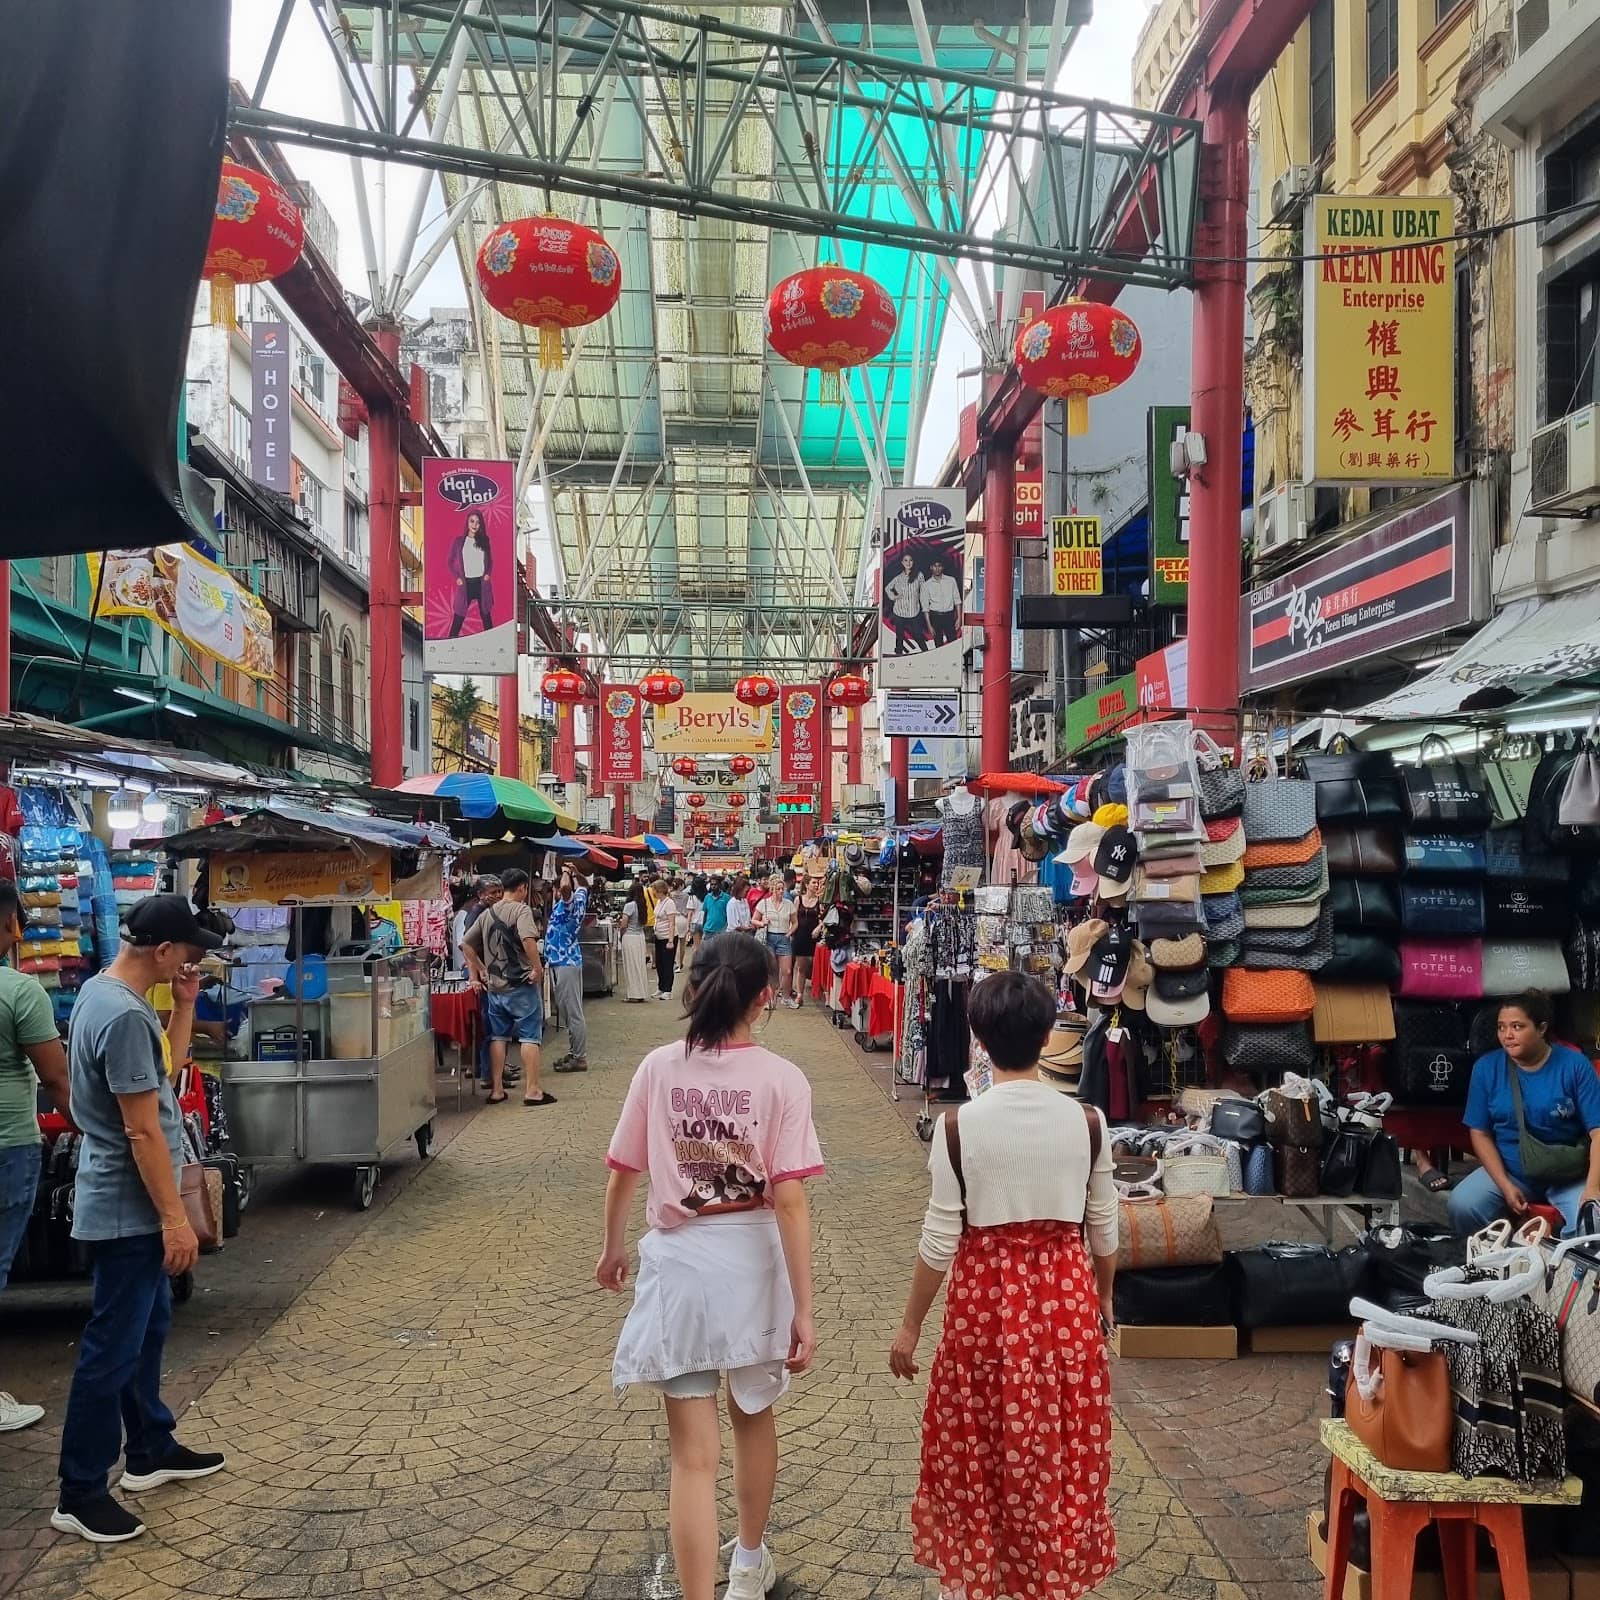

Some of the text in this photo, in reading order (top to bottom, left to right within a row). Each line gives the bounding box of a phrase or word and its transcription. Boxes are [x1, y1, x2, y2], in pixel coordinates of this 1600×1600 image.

[1327, 208, 1441, 238] KEDAI UBAT
[1322, 244, 1445, 285] KEEN HING
[1343, 288, 1425, 312] Enterprise
[262, 369, 279, 481] HOTEL
[443, 476, 476, 491] Hari
[460, 488, 493, 504] Hari
[1017, 486, 1041, 500] 60
[901, 503, 931, 519] Hari
[917, 514, 947, 529] Hari
[1052, 520, 1101, 549] HOTEL
[1053, 551, 1101, 570] PETALING
[1057, 572, 1098, 591] STREET
[1325, 619, 1341, 634] Keen
[1341, 613, 1358, 628] Hing
[1359, 598, 1396, 621] Enterprise
[677, 706, 750, 735] Beryl's
[699, 775, 714, 785] 30
[1434, 782, 1461, 790] THE
[1418, 791, 1479, 800] TOTE BAG
[1413, 839, 1475, 849] TOTE BAG
[1411, 896, 1476, 906] TOTE BAG
[1429, 953, 1457, 962] THE
[1411, 962, 1474, 973] TOTE BAG
[671, 1087, 752, 1119] BRAVE
[682, 1119, 739, 1141] LOYAL
[675, 1140, 755, 1164] HUNGRY
